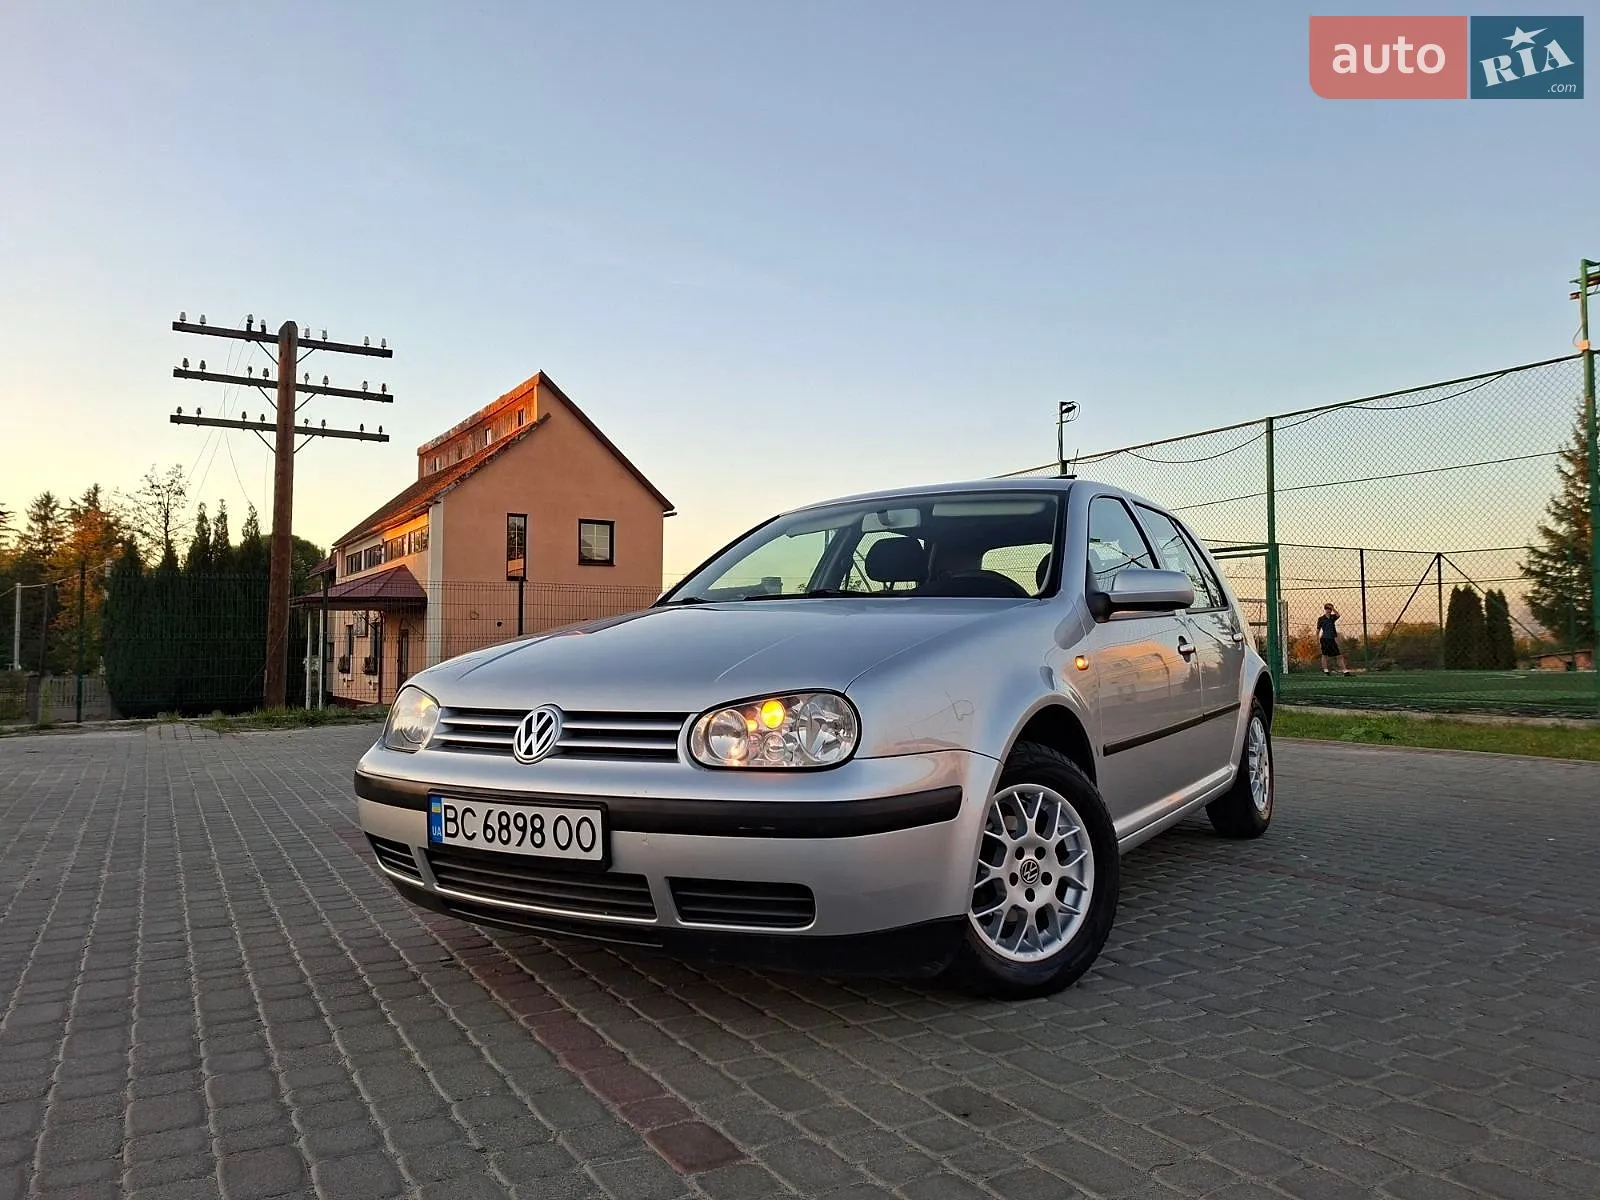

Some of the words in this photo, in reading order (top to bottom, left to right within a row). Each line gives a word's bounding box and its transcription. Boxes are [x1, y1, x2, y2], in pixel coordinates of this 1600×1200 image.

[432, 825, 442, 837] UA
[443, 804, 477, 841] BC
[482, 809, 546, 849] 6898
[552, 814, 597, 853] OO
